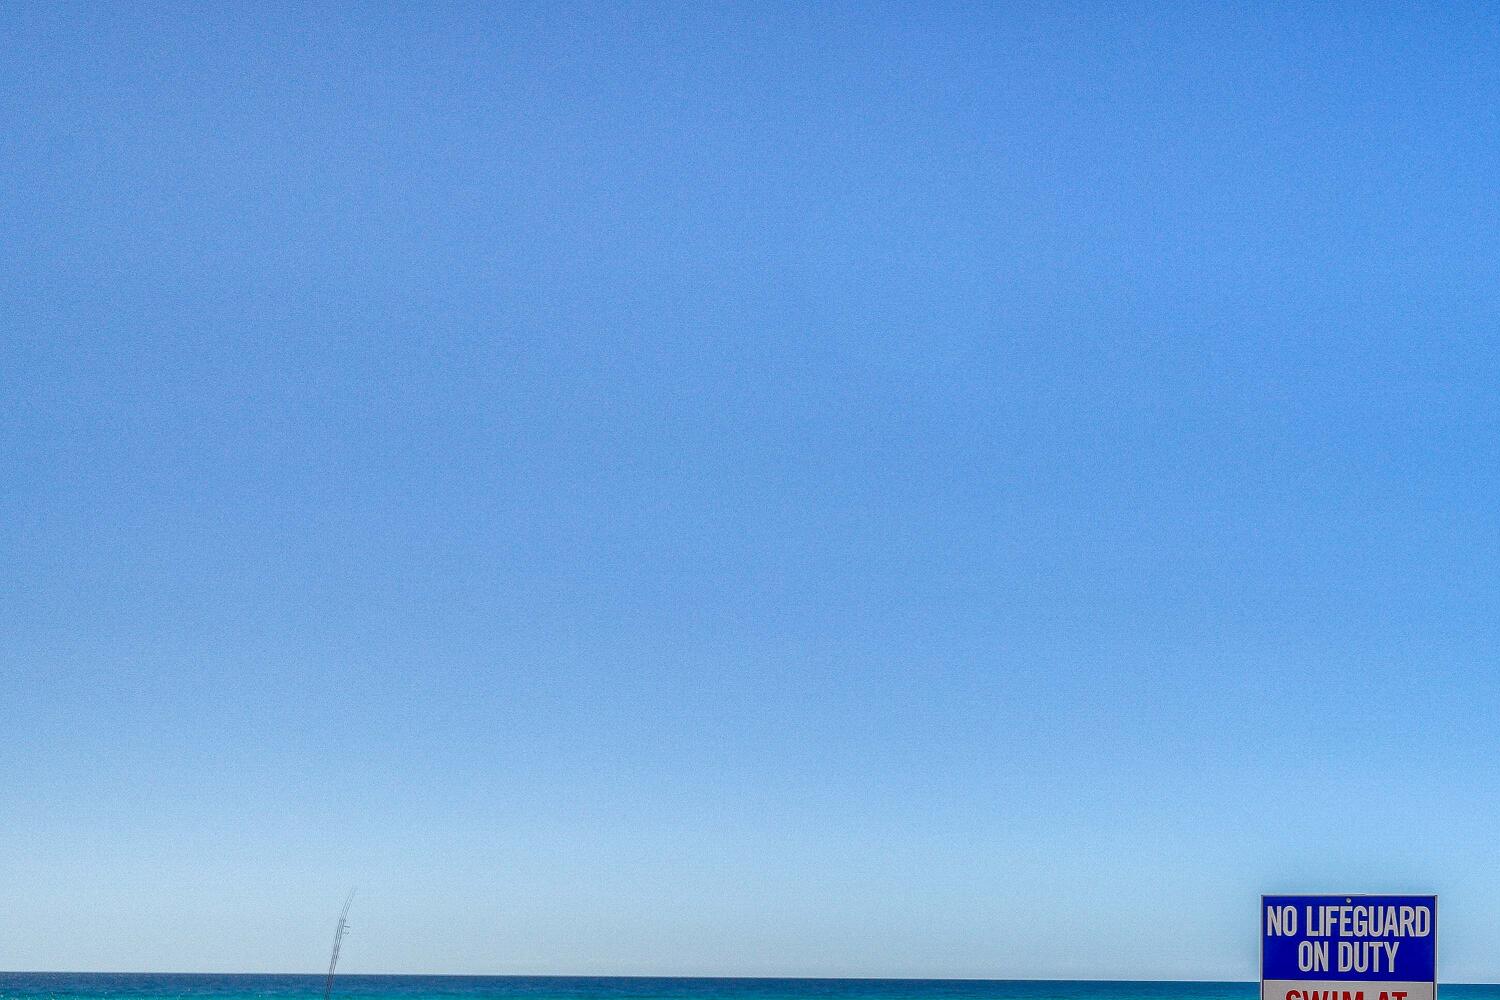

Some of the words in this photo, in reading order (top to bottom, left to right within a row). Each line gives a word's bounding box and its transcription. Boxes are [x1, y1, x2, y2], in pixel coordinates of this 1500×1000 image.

[1267, 905, 1298, 937] NO
[1306, 905, 1431, 937] LIFEGUARD
[1298, 941, 1329, 972] ON
[1338, 942, 1400, 973] DUTY
